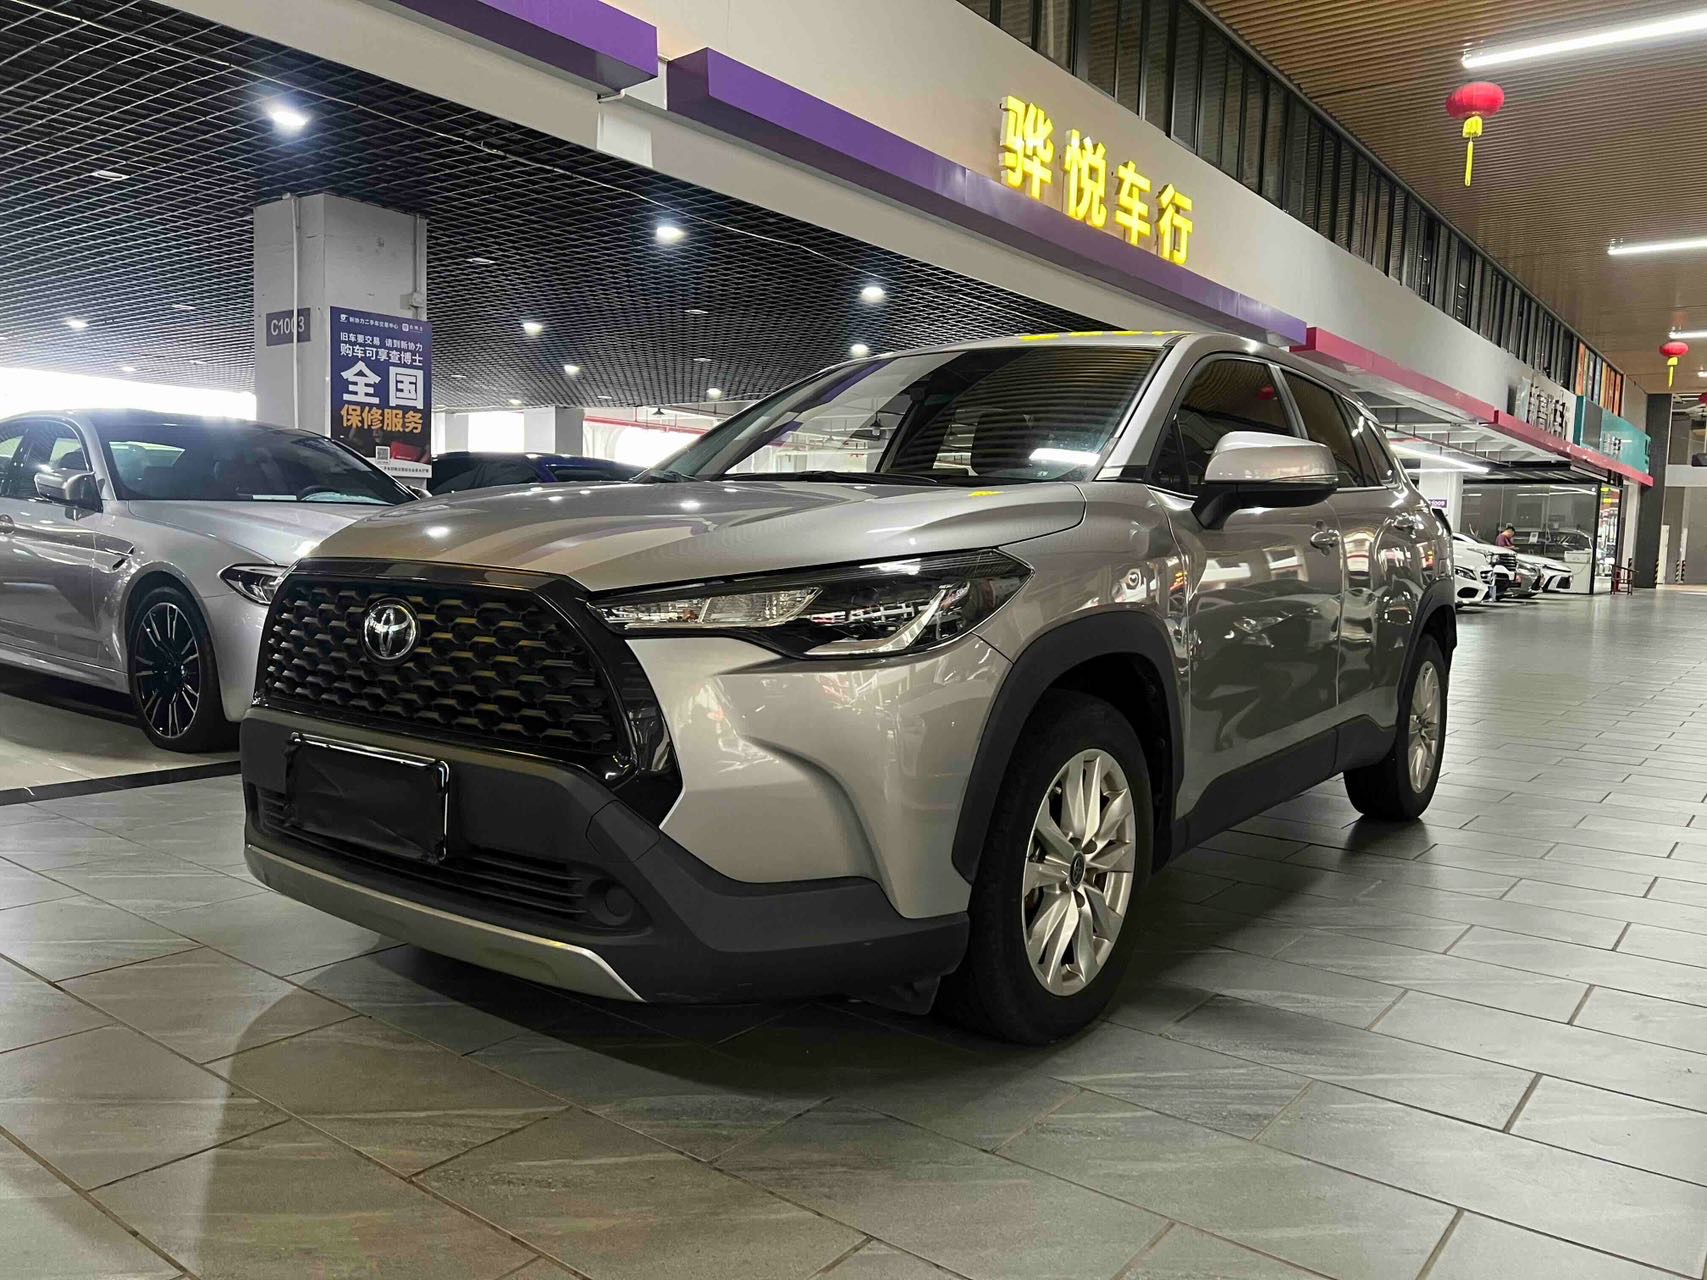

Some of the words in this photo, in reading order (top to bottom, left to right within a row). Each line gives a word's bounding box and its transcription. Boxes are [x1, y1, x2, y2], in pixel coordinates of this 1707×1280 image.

[999, 95, 1193, 266] 骅悦车行
[340, 331, 380, 346] 旧车要交易
[385, 338, 423, 352] 请到新协力
[340, 343, 423, 366] 购车可享查博士
[340, 360, 424, 409] 全国
[340, 404, 423, 433] 保修服务
